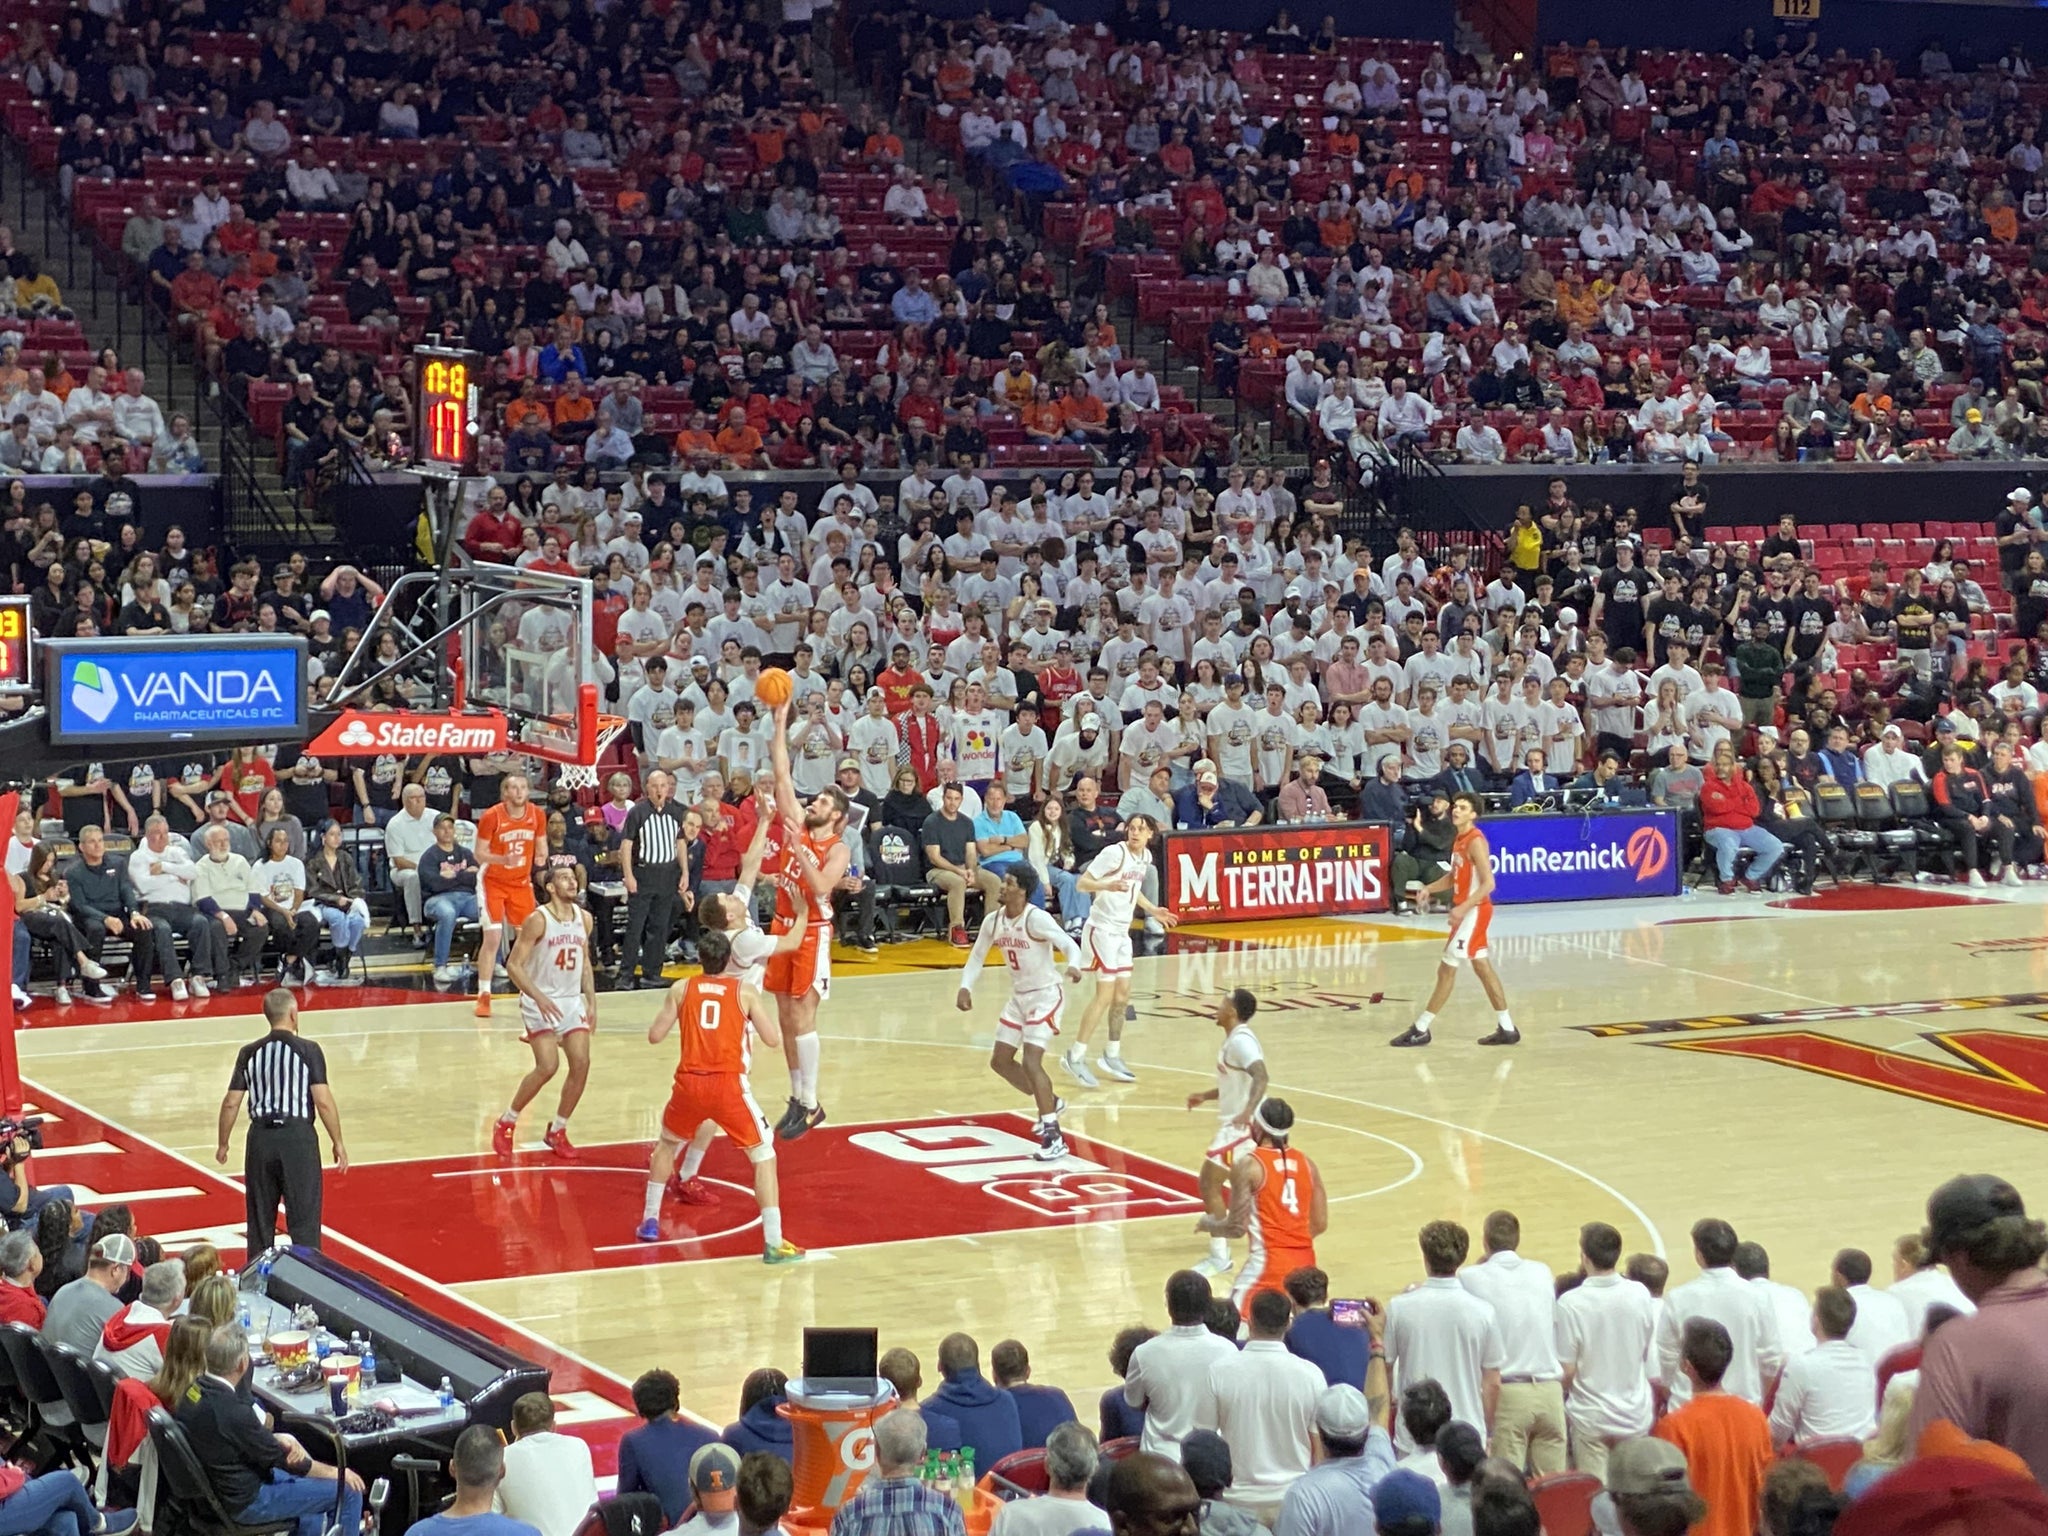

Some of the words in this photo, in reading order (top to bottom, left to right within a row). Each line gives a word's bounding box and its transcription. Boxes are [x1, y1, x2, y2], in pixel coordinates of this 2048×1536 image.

[1783, 0, 1810, 15] 112
[120, 669, 283, 707] VANDA
[134, 707, 259, 721] PHARMACEUTICALS
[376, 721, 496, 748] StateFarm
[1232, 849, 1286, 864] HOME
[1299, 847, 1322, 861] OF
[1335, 844, 1372, 858] THE
[1489, 842, 1626, 874] ohnReznick
[1177, 852, 1220, 905] M
[1223, 858, 1381, 908] TERRAPINS
[554, 948, 576, 971] 45
[1007, 950, 1020, 971] 9
[700, 999, 721, 1030] 0
[1280, 1178, 1300, 1215] 4
